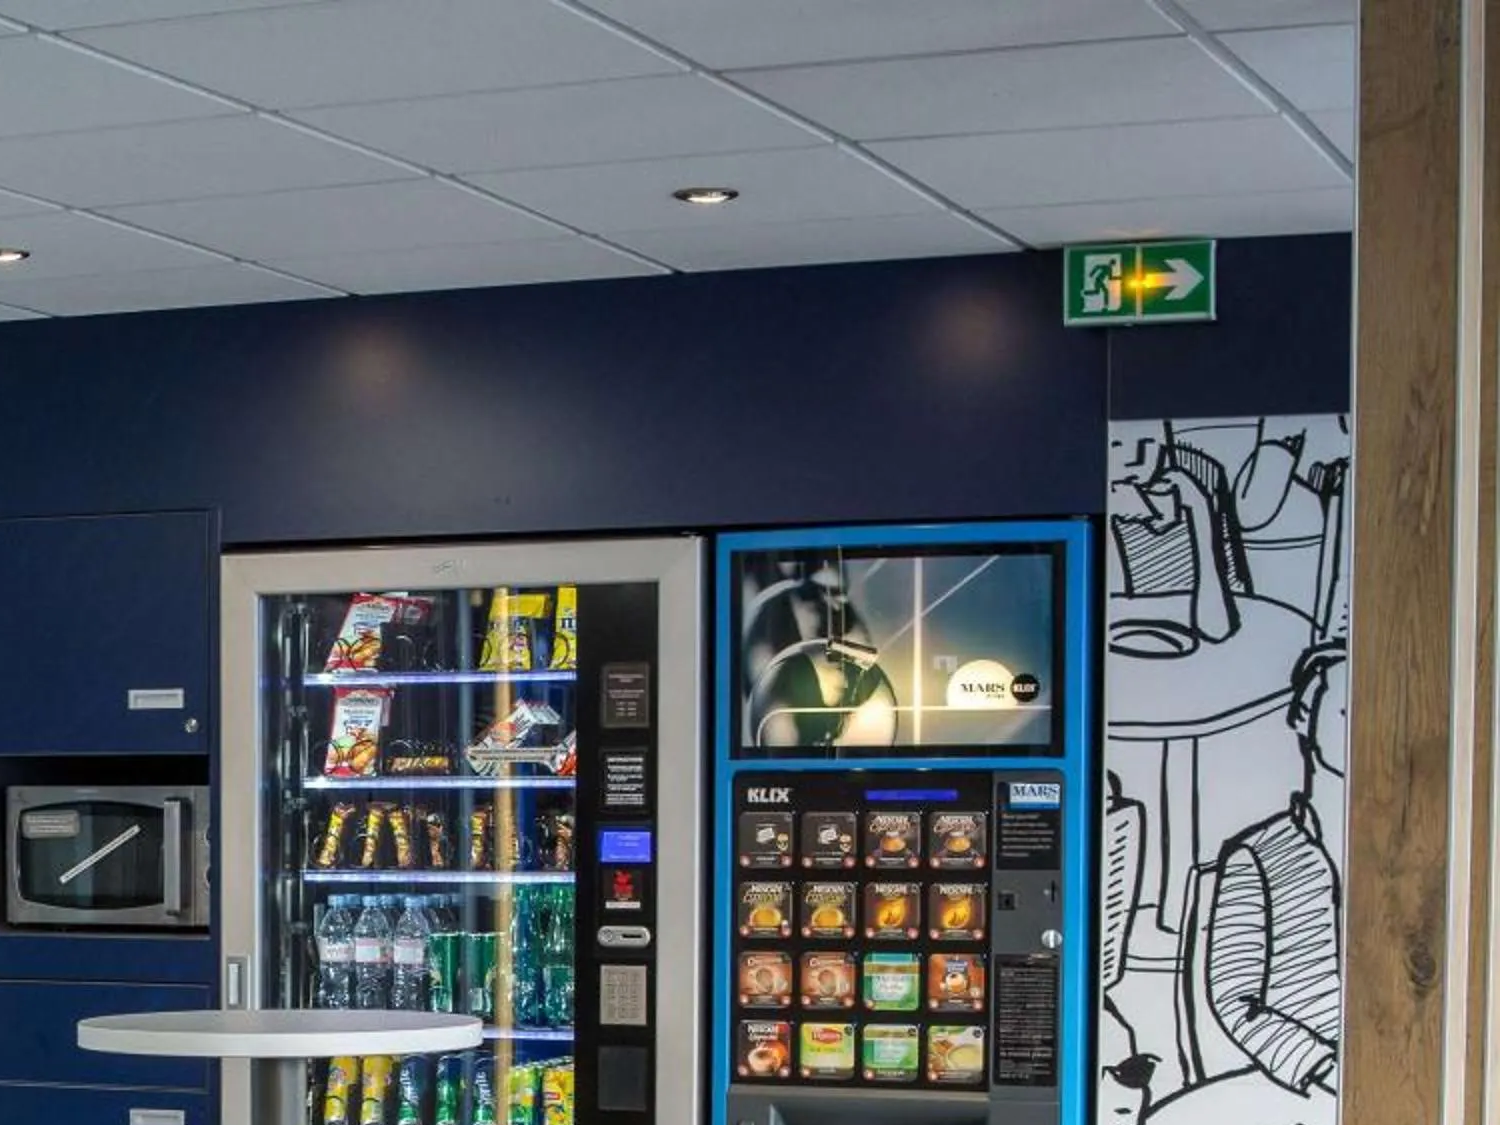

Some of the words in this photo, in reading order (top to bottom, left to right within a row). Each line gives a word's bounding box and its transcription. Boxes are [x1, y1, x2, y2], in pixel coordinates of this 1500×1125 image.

[960, 682, 1005, 693] MARS
[747, 786, 790, 803] KLIX
[1013, 785, 1059, 798] MARS
